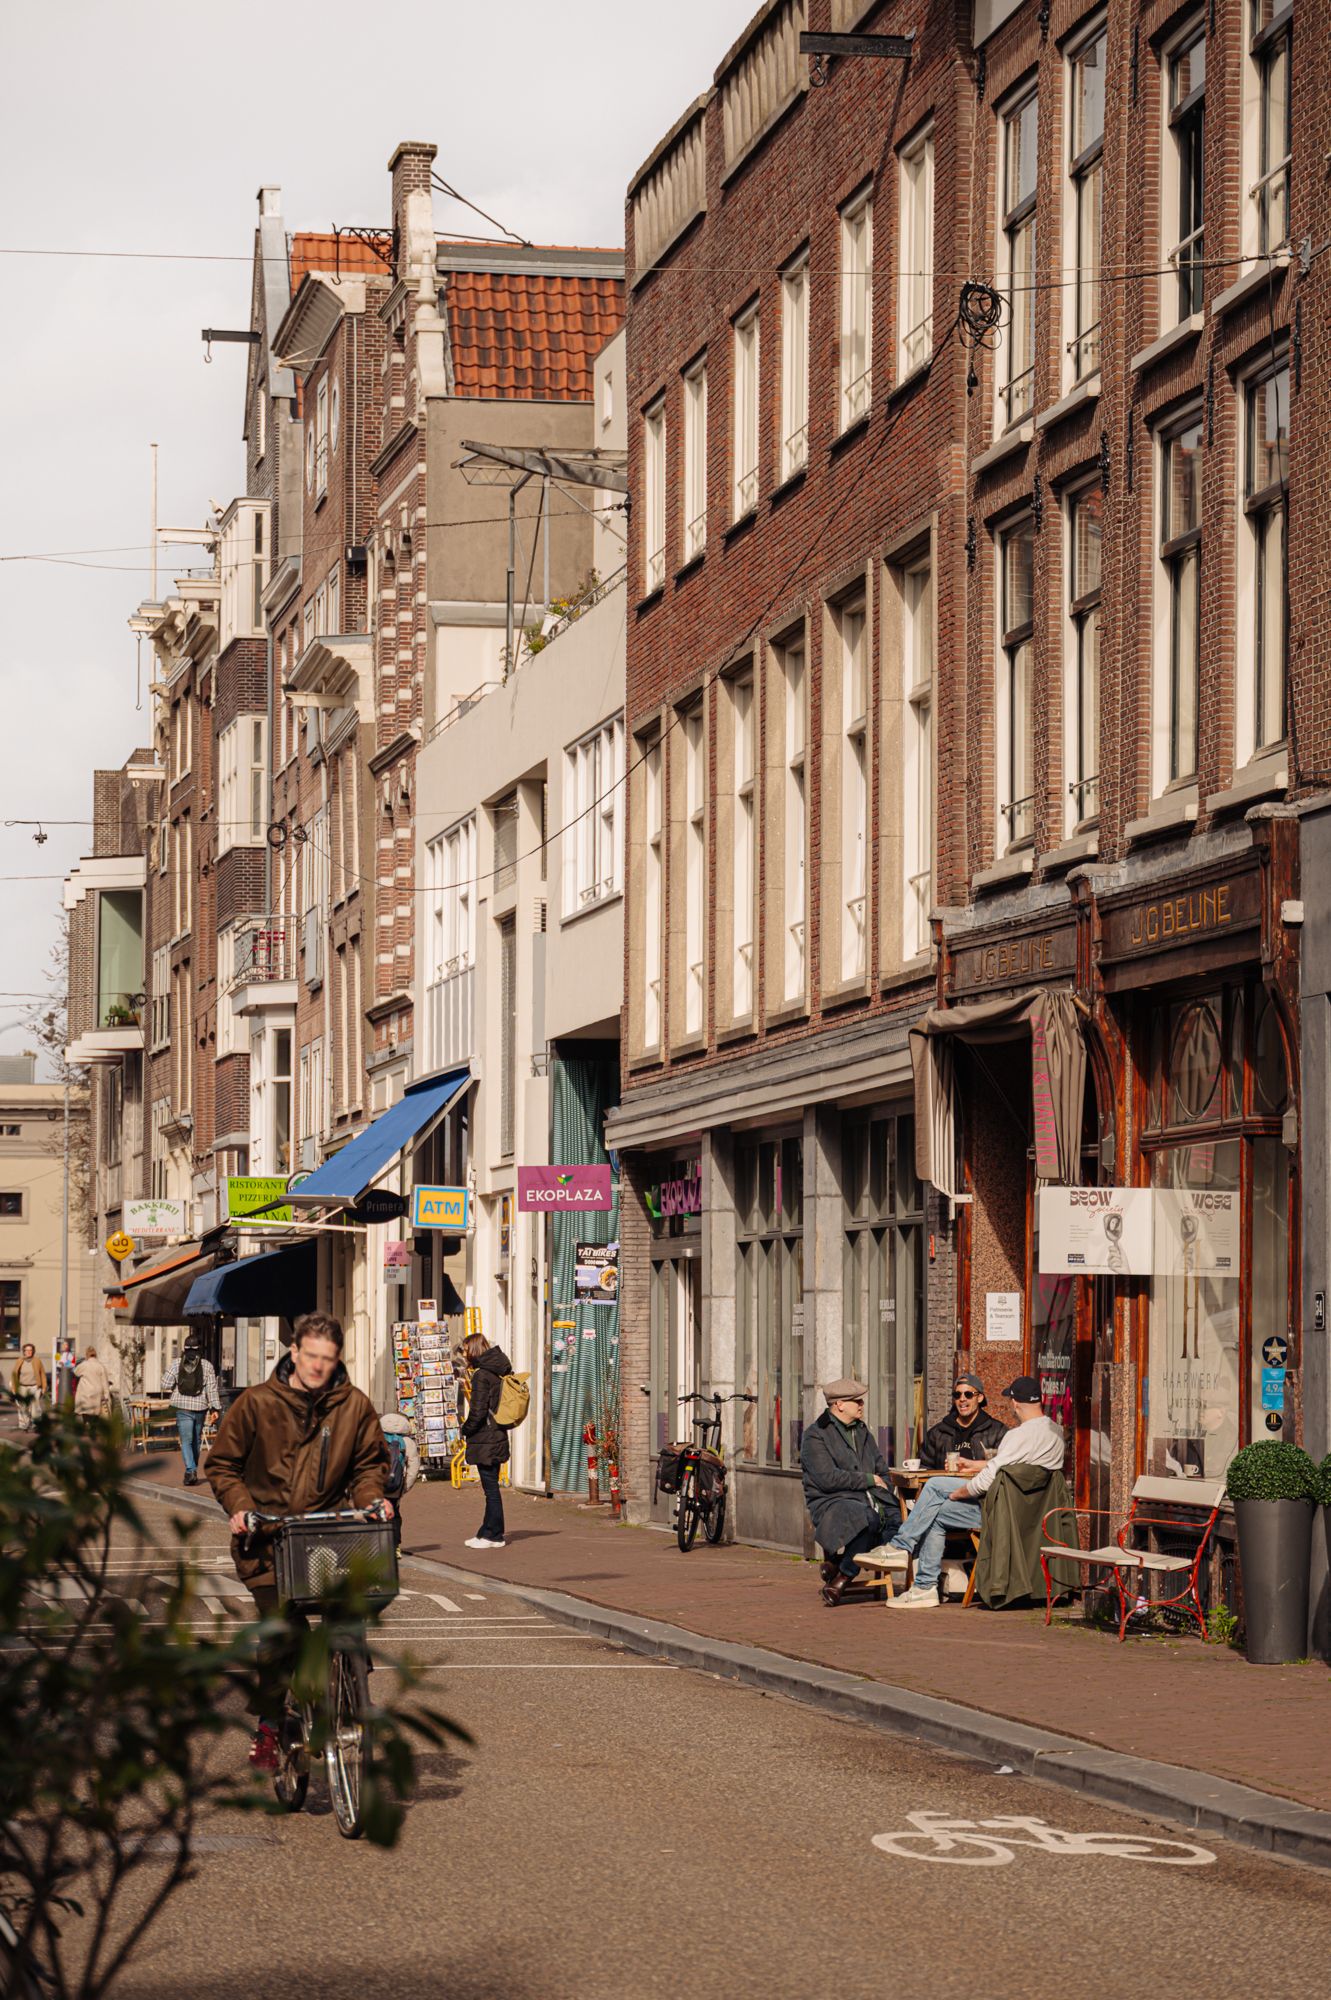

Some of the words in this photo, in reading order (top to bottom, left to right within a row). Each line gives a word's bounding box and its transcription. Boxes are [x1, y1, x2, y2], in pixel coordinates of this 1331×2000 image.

[1034, 1093, 1058, 1165] HARTIG
[239, 1194, 280, 1202] PIZZERIA
[526, 1189, 603, 1202] EKOPLAZA
[660, 1176, 702, 1217] EKOPLAZ
[1070, 1190, 1113, 1206] BROW
[130, 1201, 180, 1215] BAKKERIJ
[366, 1200, 404, 1213] Primera
[423, 1200, 461, 1216] ATM
